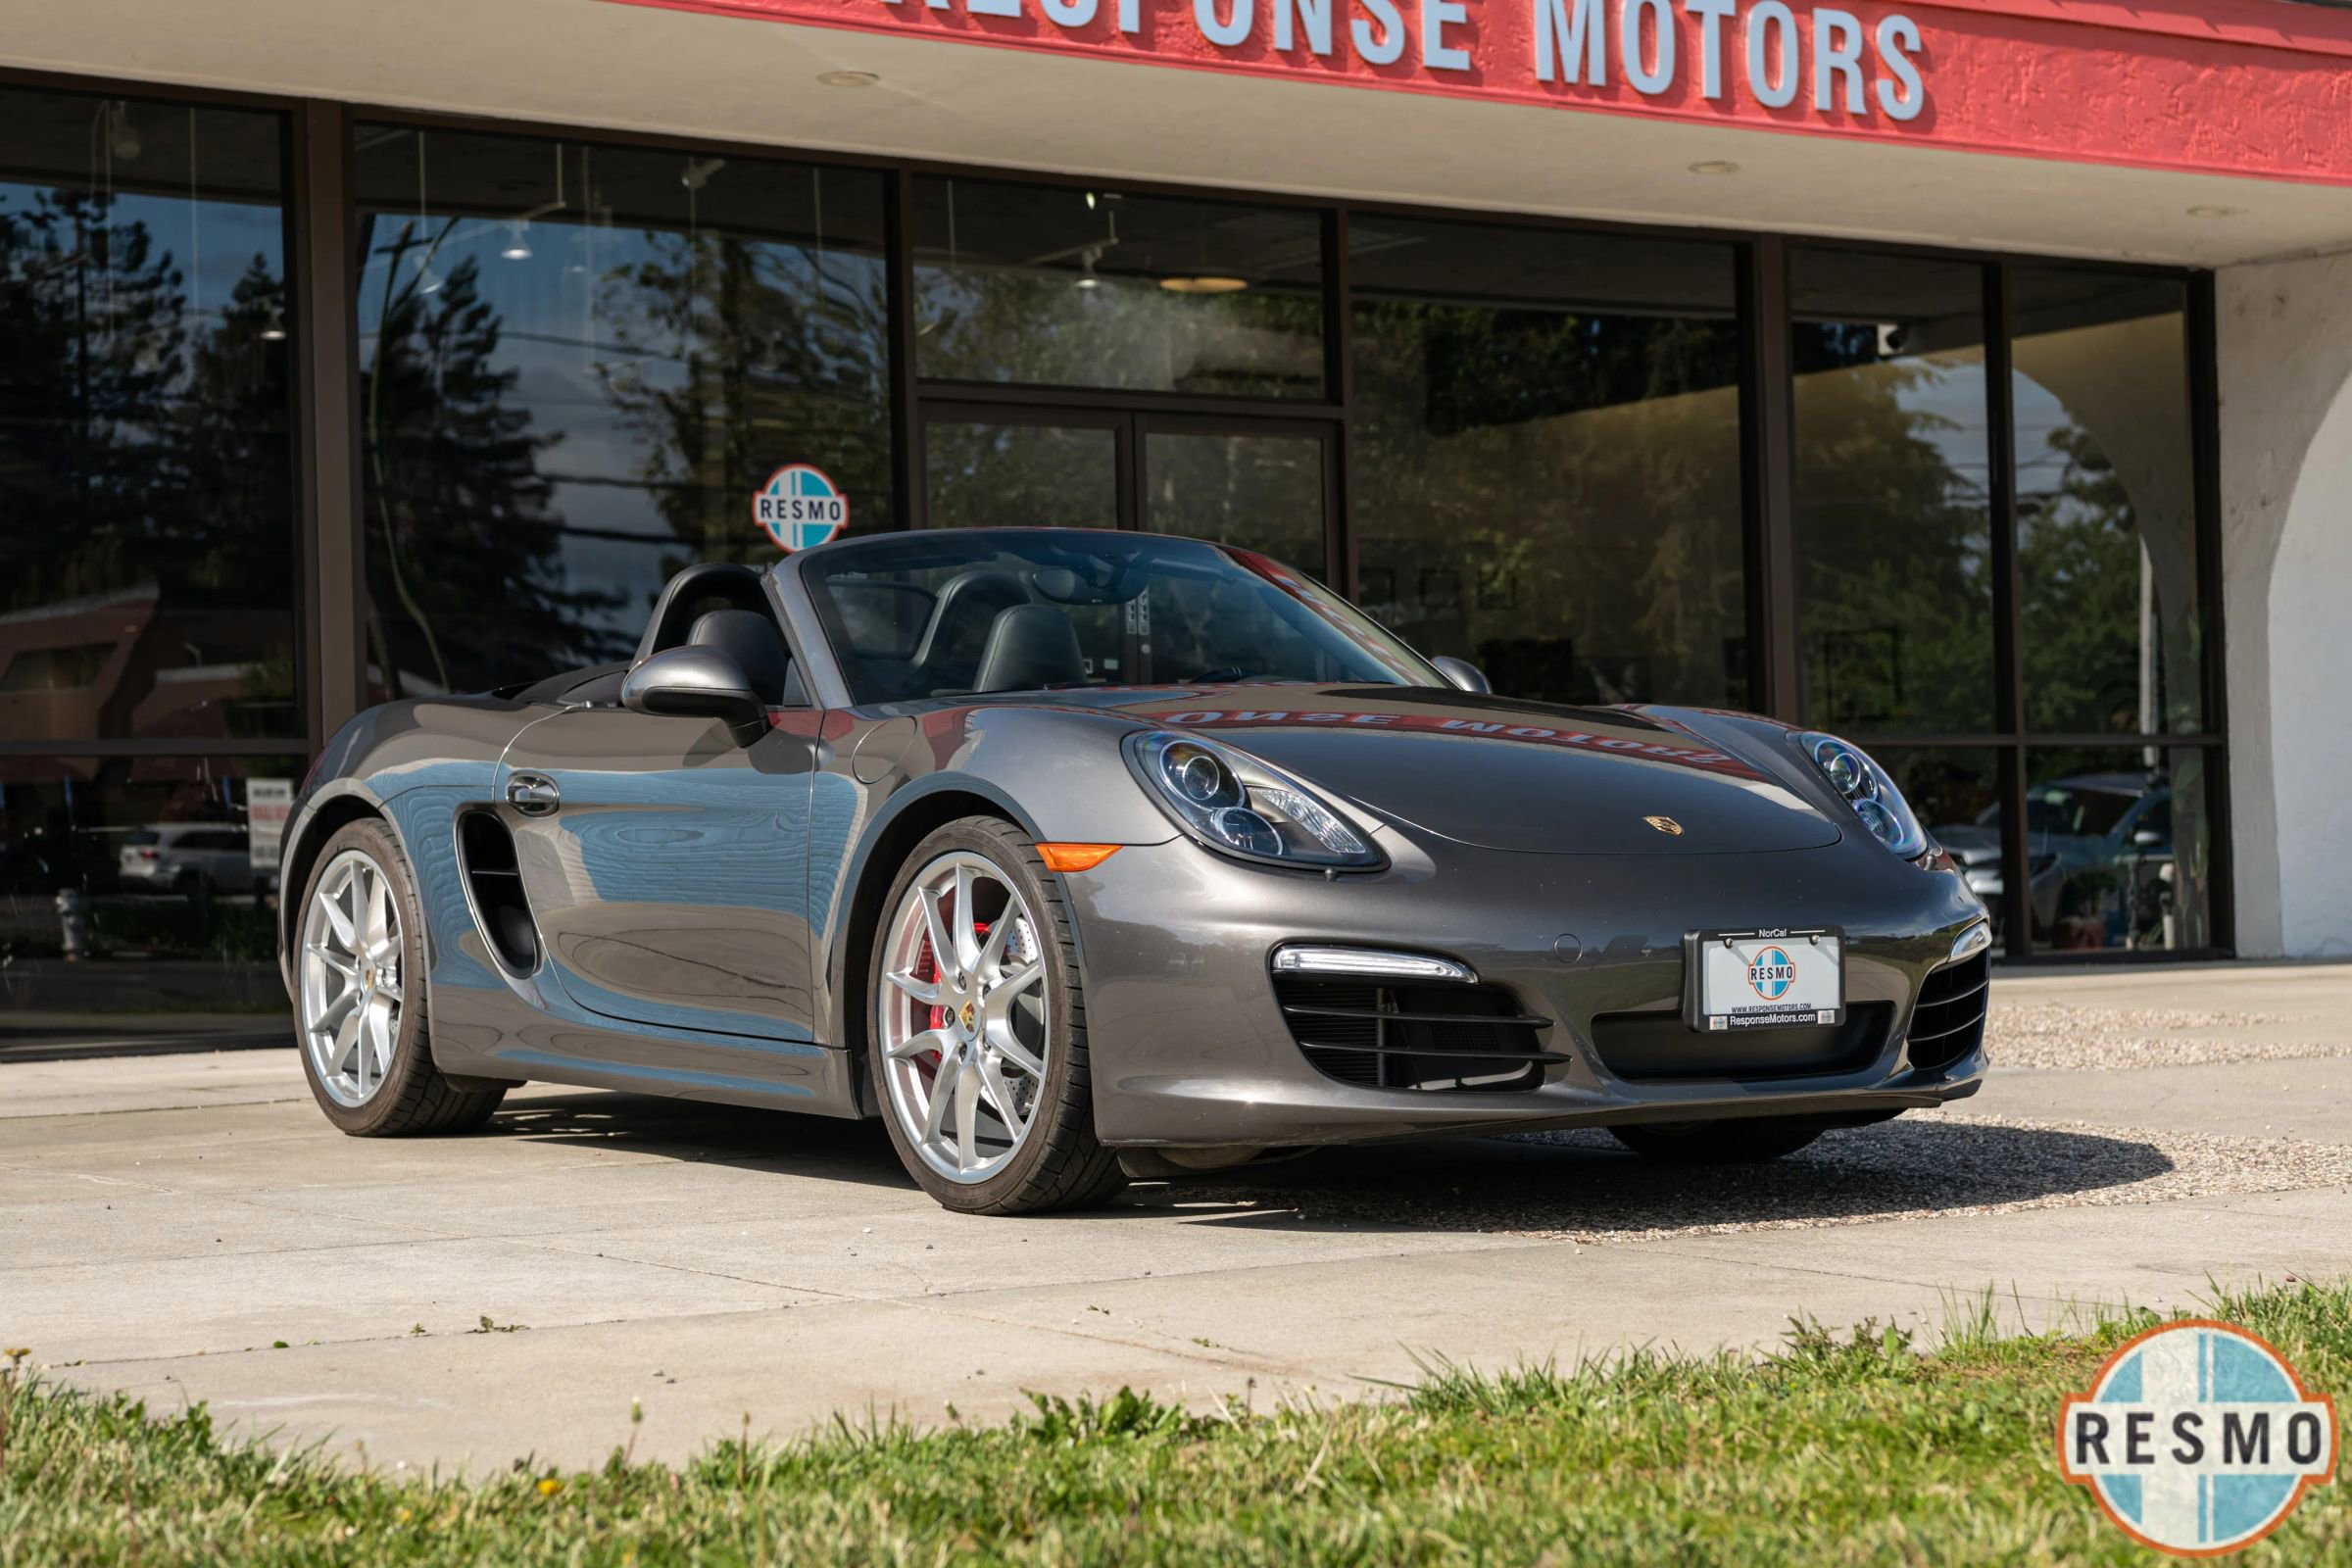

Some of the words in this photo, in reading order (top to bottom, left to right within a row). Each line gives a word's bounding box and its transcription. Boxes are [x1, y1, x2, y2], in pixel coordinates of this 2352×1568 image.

[1535, 0, 1924, 122] MOTORS
[760, 499, 841, 520] RESMO
[1758, 928, 1788, 938] NorCal
[1750, 966, 1793, 981] RESMO
[1731, 1003, 1812, 1014] WWW.RESPONSEMOTORS.COM
[1730, 1013, 1816, 1027] ResponseMotors.com
